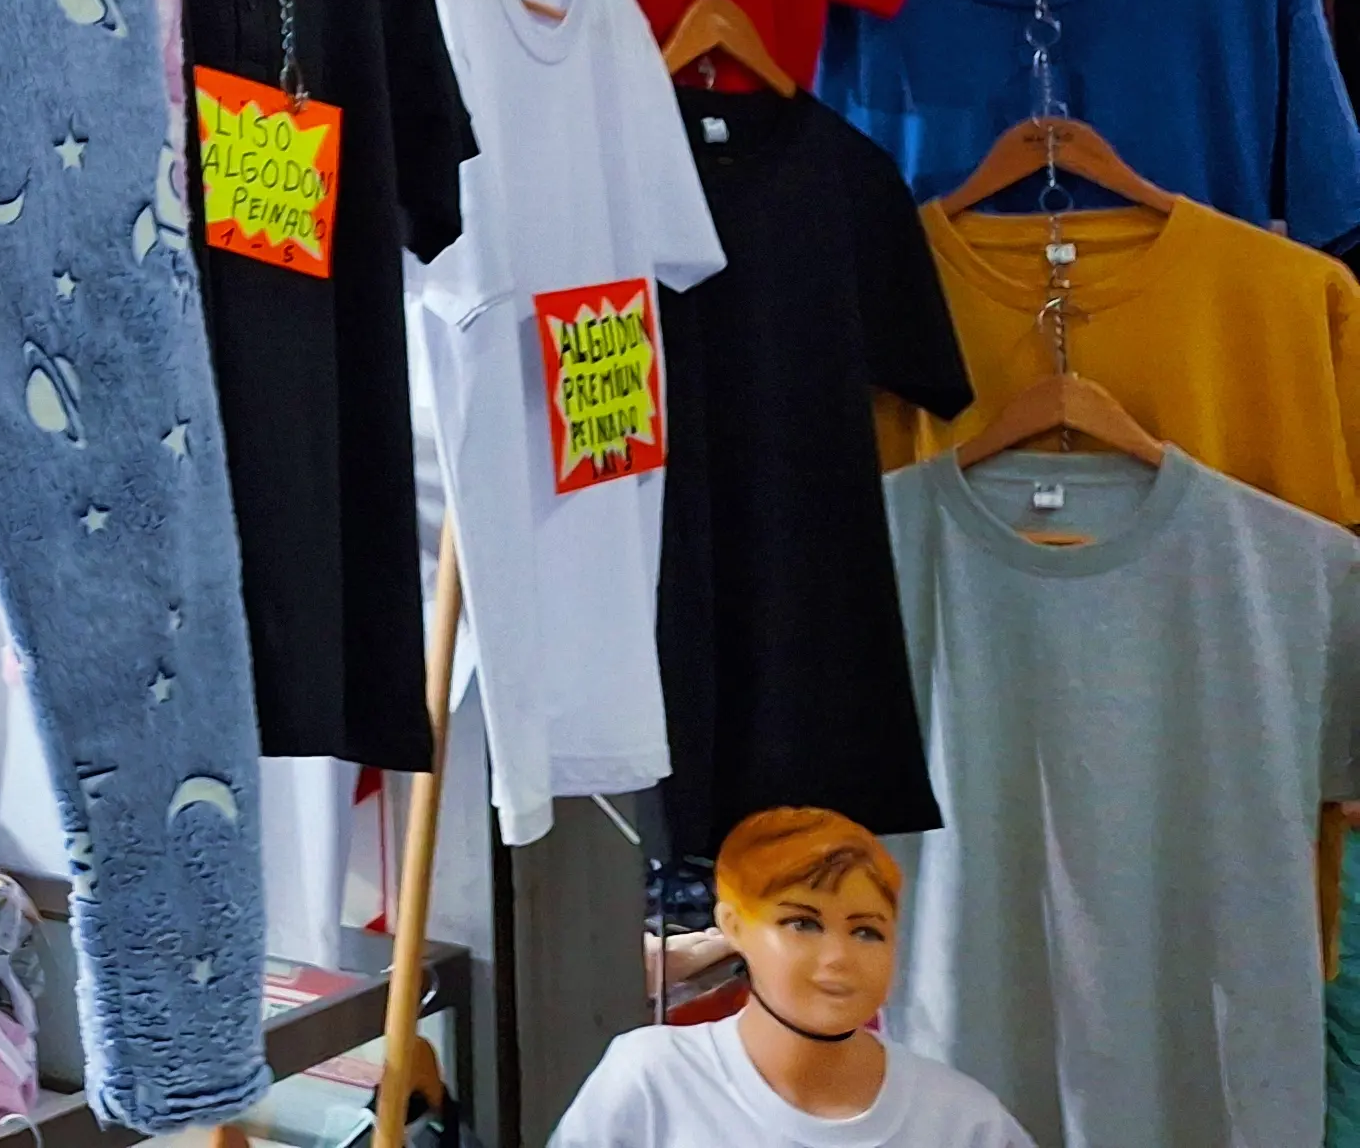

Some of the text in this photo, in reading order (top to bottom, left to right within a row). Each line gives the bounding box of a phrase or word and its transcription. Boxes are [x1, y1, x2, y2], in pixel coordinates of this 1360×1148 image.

[214, 96, 292, 152] LISO
[202, 143, 334, 201] ALGODON
[231, 186, 327, 240] PEINADO
